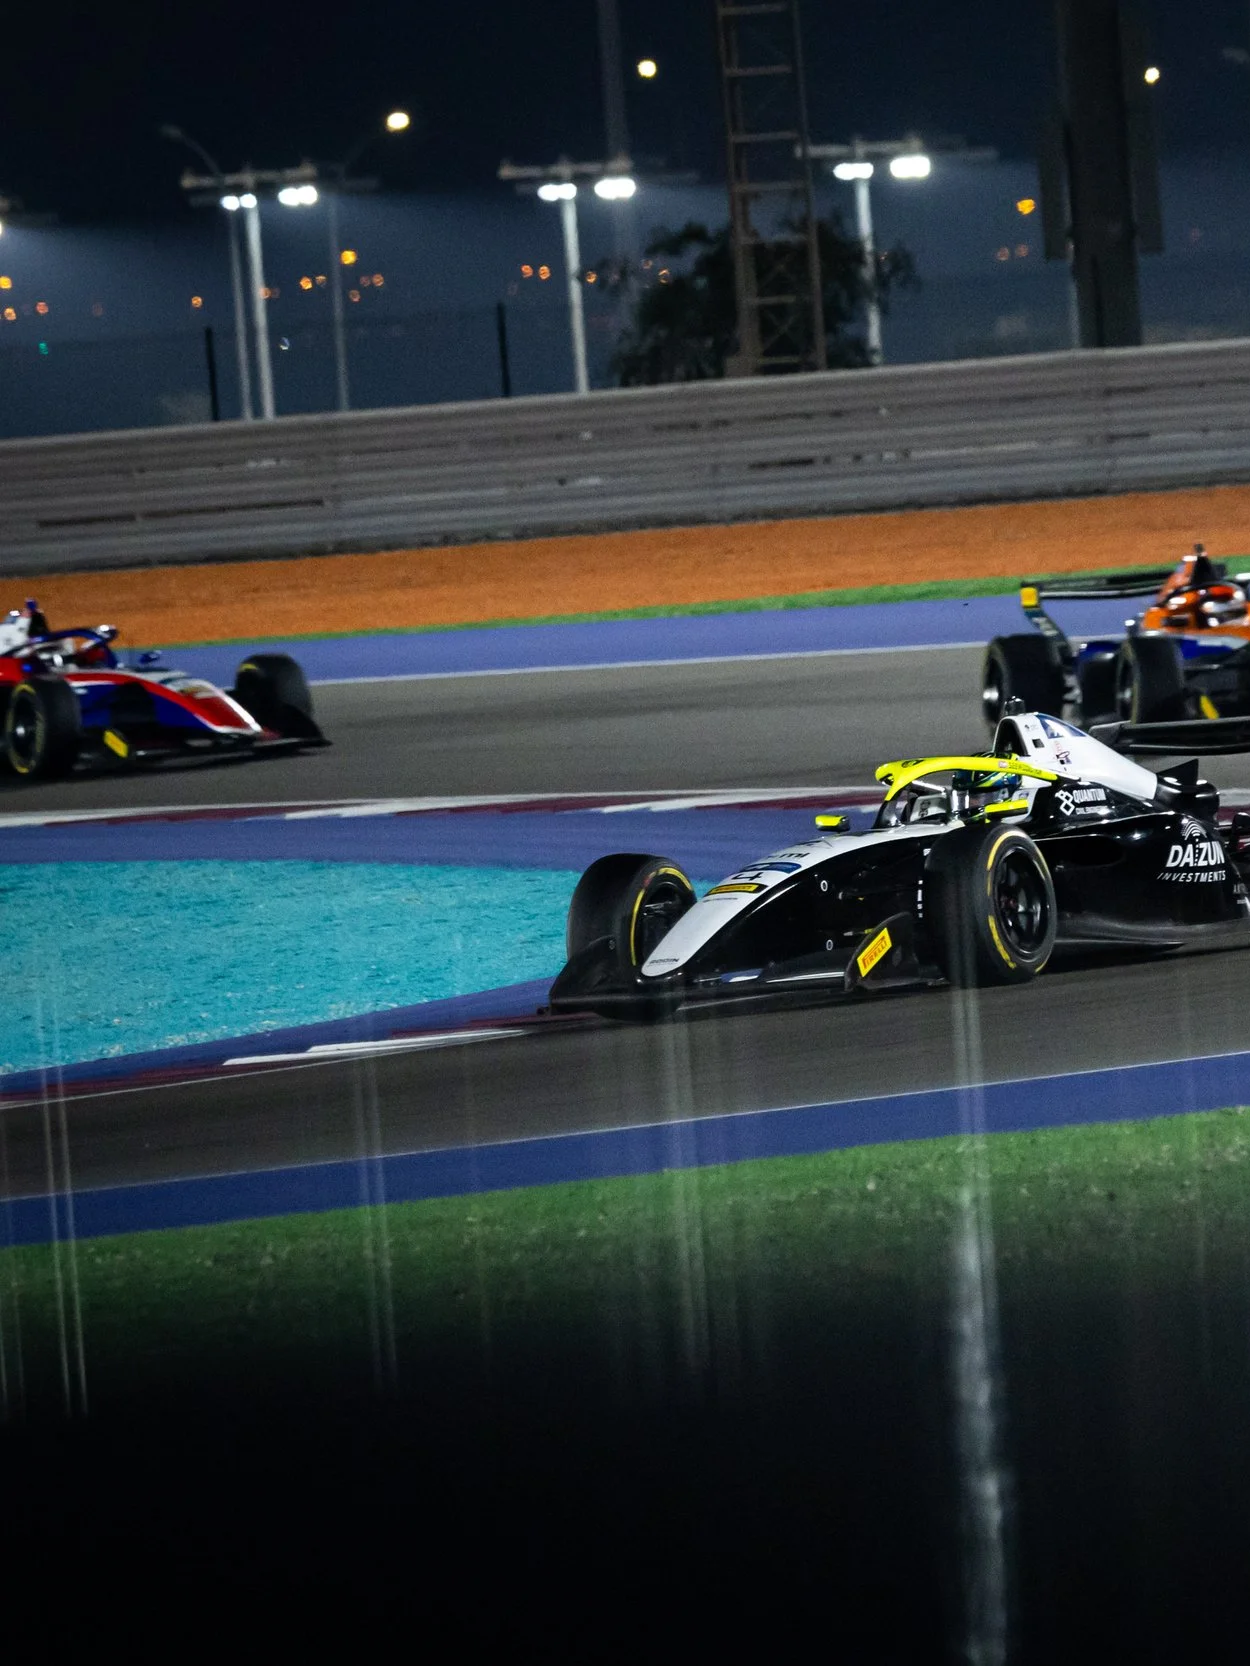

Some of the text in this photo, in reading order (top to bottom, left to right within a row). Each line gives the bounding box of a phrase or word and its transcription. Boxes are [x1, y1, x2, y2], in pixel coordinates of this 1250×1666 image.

[1072, 788, 1107, 804] QUANTUM
[1157, 870, 1226, 883] INVESTMENTS
[861, 935, 888, 970] PIRELLI
